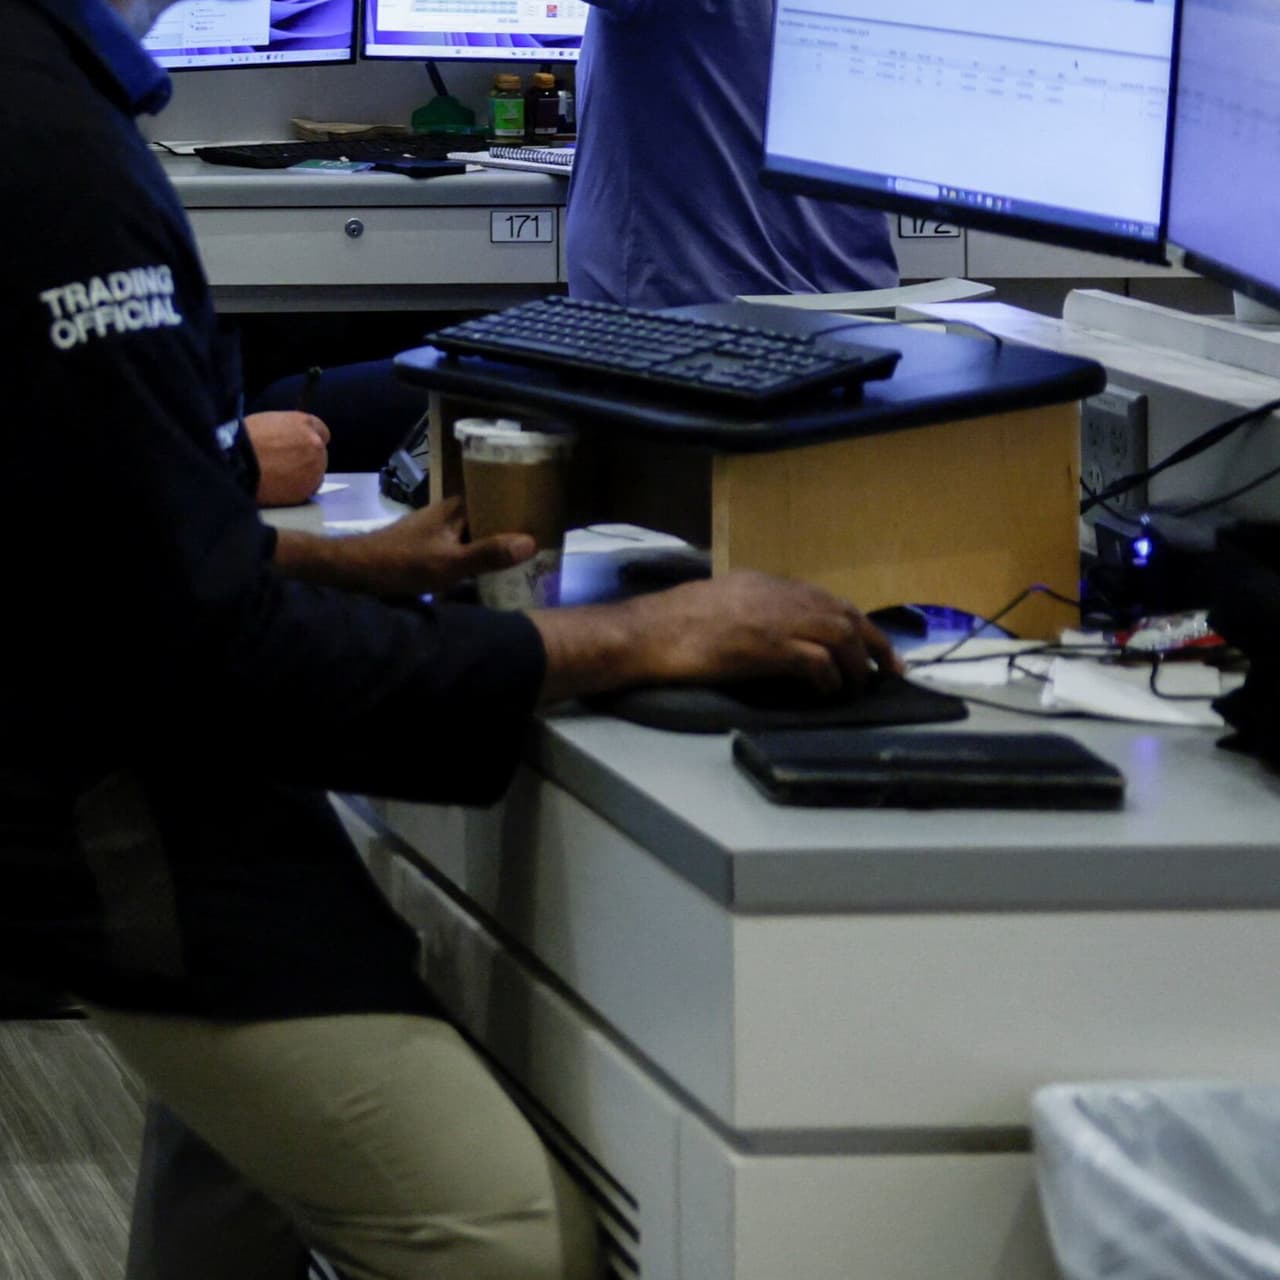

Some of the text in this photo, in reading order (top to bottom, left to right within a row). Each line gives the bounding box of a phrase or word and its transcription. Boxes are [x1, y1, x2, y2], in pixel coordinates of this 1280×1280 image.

[504, 214, 540, 239] 171
[39, 264, 175, 320] TRADING
[50, 295, 182, 350] OFFICIAL
